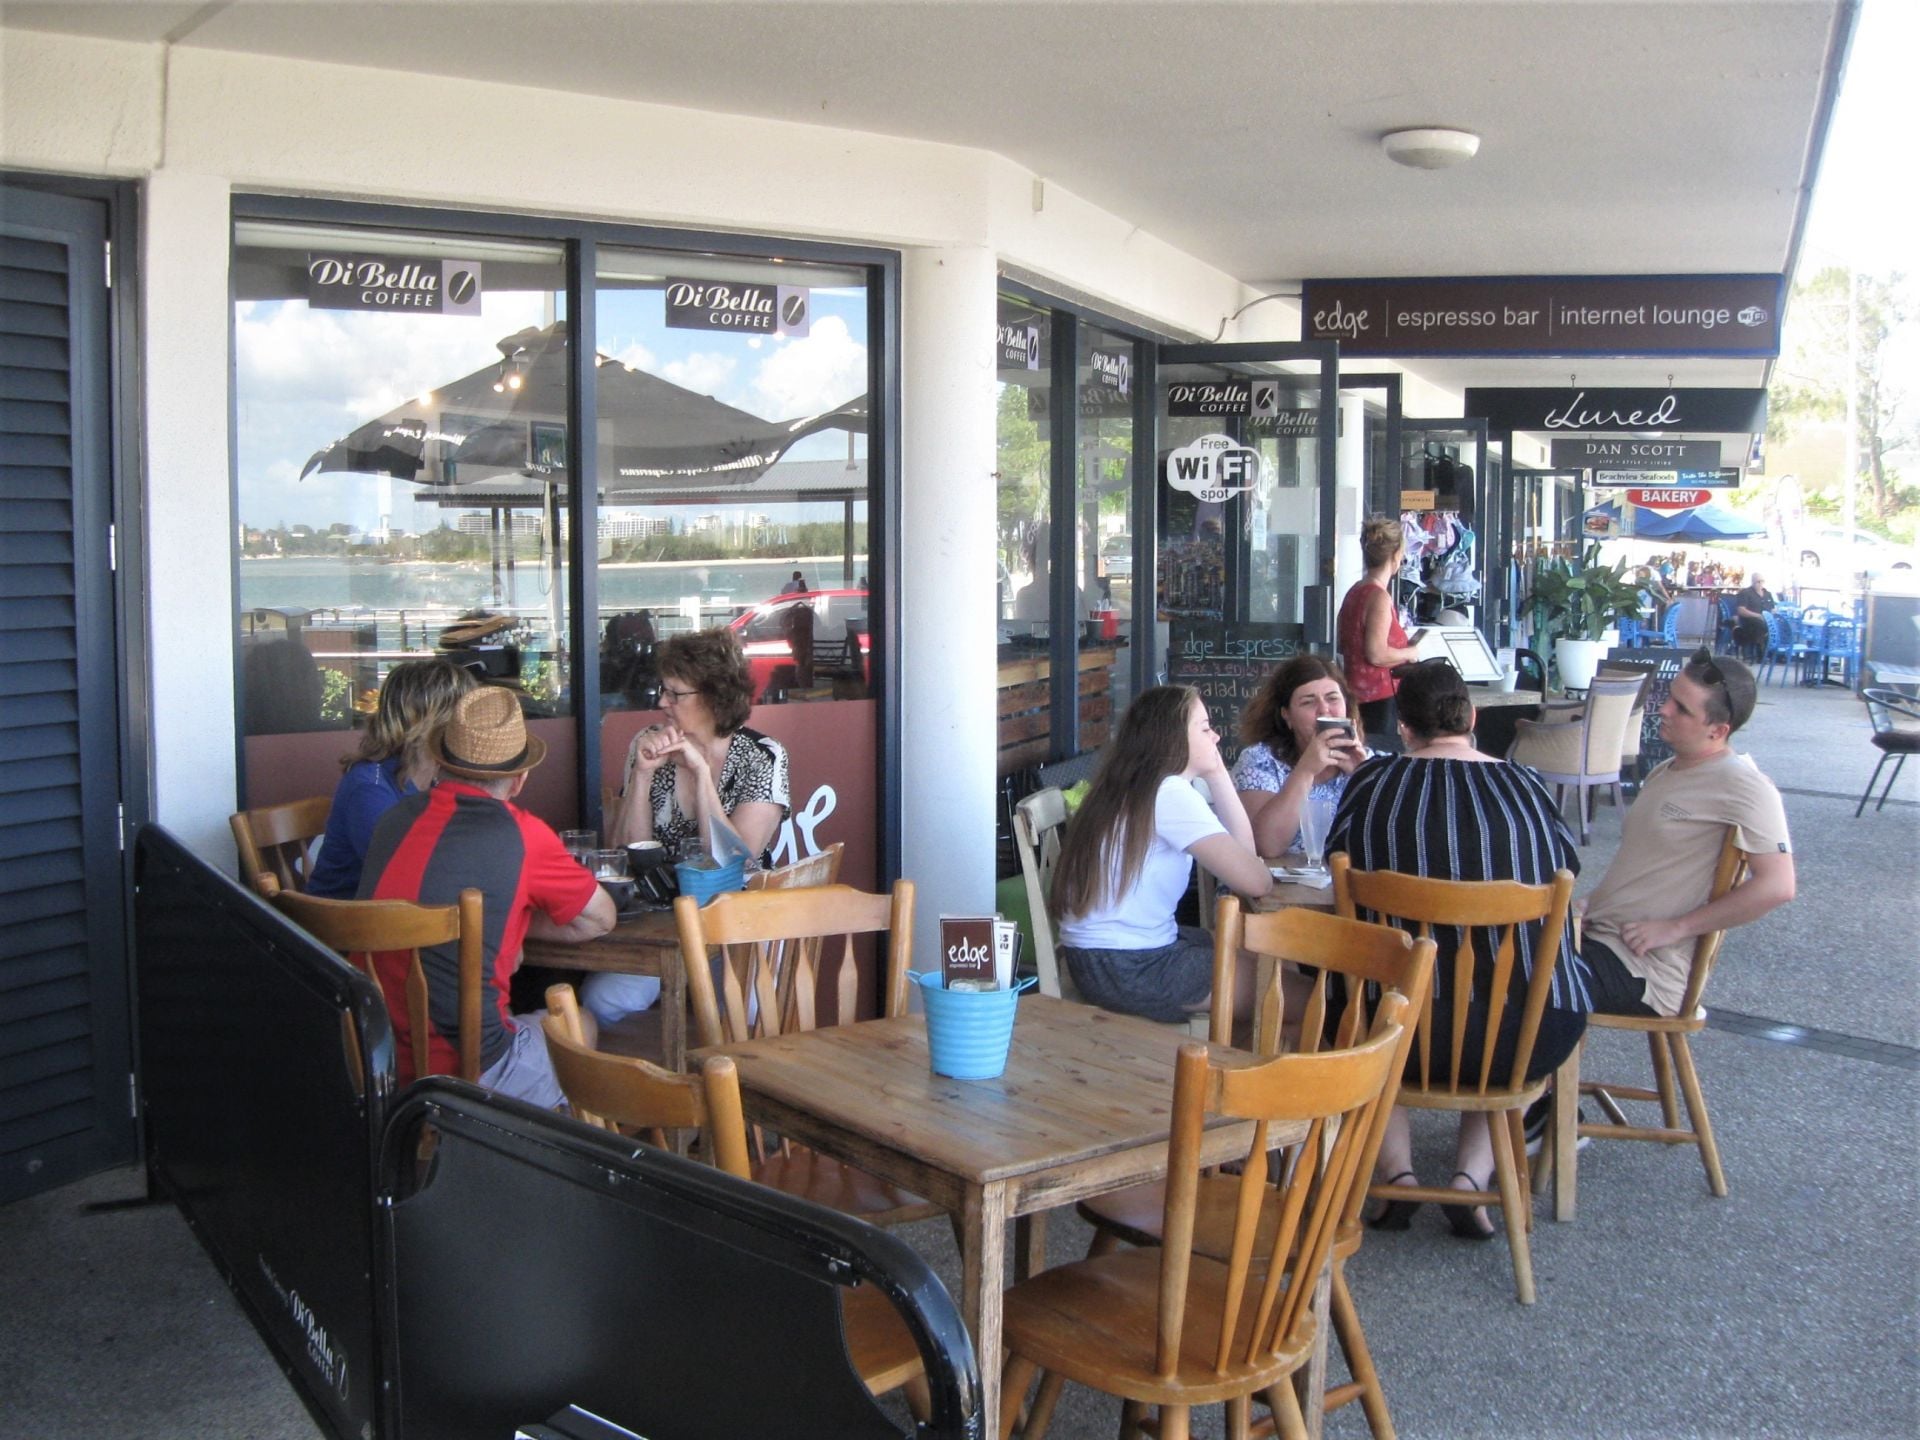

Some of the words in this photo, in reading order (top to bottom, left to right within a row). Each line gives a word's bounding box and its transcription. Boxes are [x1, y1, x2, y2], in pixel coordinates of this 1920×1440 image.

[309, 259, 354, 286] Di
[357, 262, 440, 291] Bella
[361, 291, 434, 307] COFFEE
[666, 282, 704, 308] Di
[705, 286, 774, 314] Bella
[709, 312, 770, 328] COFFEE
[1313, 300, 1370, 339] edge
[1397, 311, 1496, 331] espresso
[1503, 306, 1540, 326] bar
[1560, 305, 1646, 325] internet
[1653, 305, 1730, 329] lounge
[1004, 326, 1027, 350] Bella
[1005, 348, 1027, 363] COFFEE
[1091, 352, 1102, 371] Di
[1102, 355, 1119, 376] Bella
[1102, 374, 1118, 386] COFFEE
[1168, 385, 1196, 402] Di
[1197, 385, 1249, 403] Bella
[1199, 404, 1246, 413] COFFEE
[1544, 391, 1682, 428] Lured
[1273, 411, 1319, 427] Bella
[1276, 426, 1317, 435] COFFEE
[1200, 439, 1230, 450] Free
[1586, 443, 1622, 455] DAN
[1630, 444, 1687, 457] SCOTT
[1200, 488, 1230, 501] spot
[1641, 490, 1699, 503] BAKERY
[948, 936, 989, 970] edge
